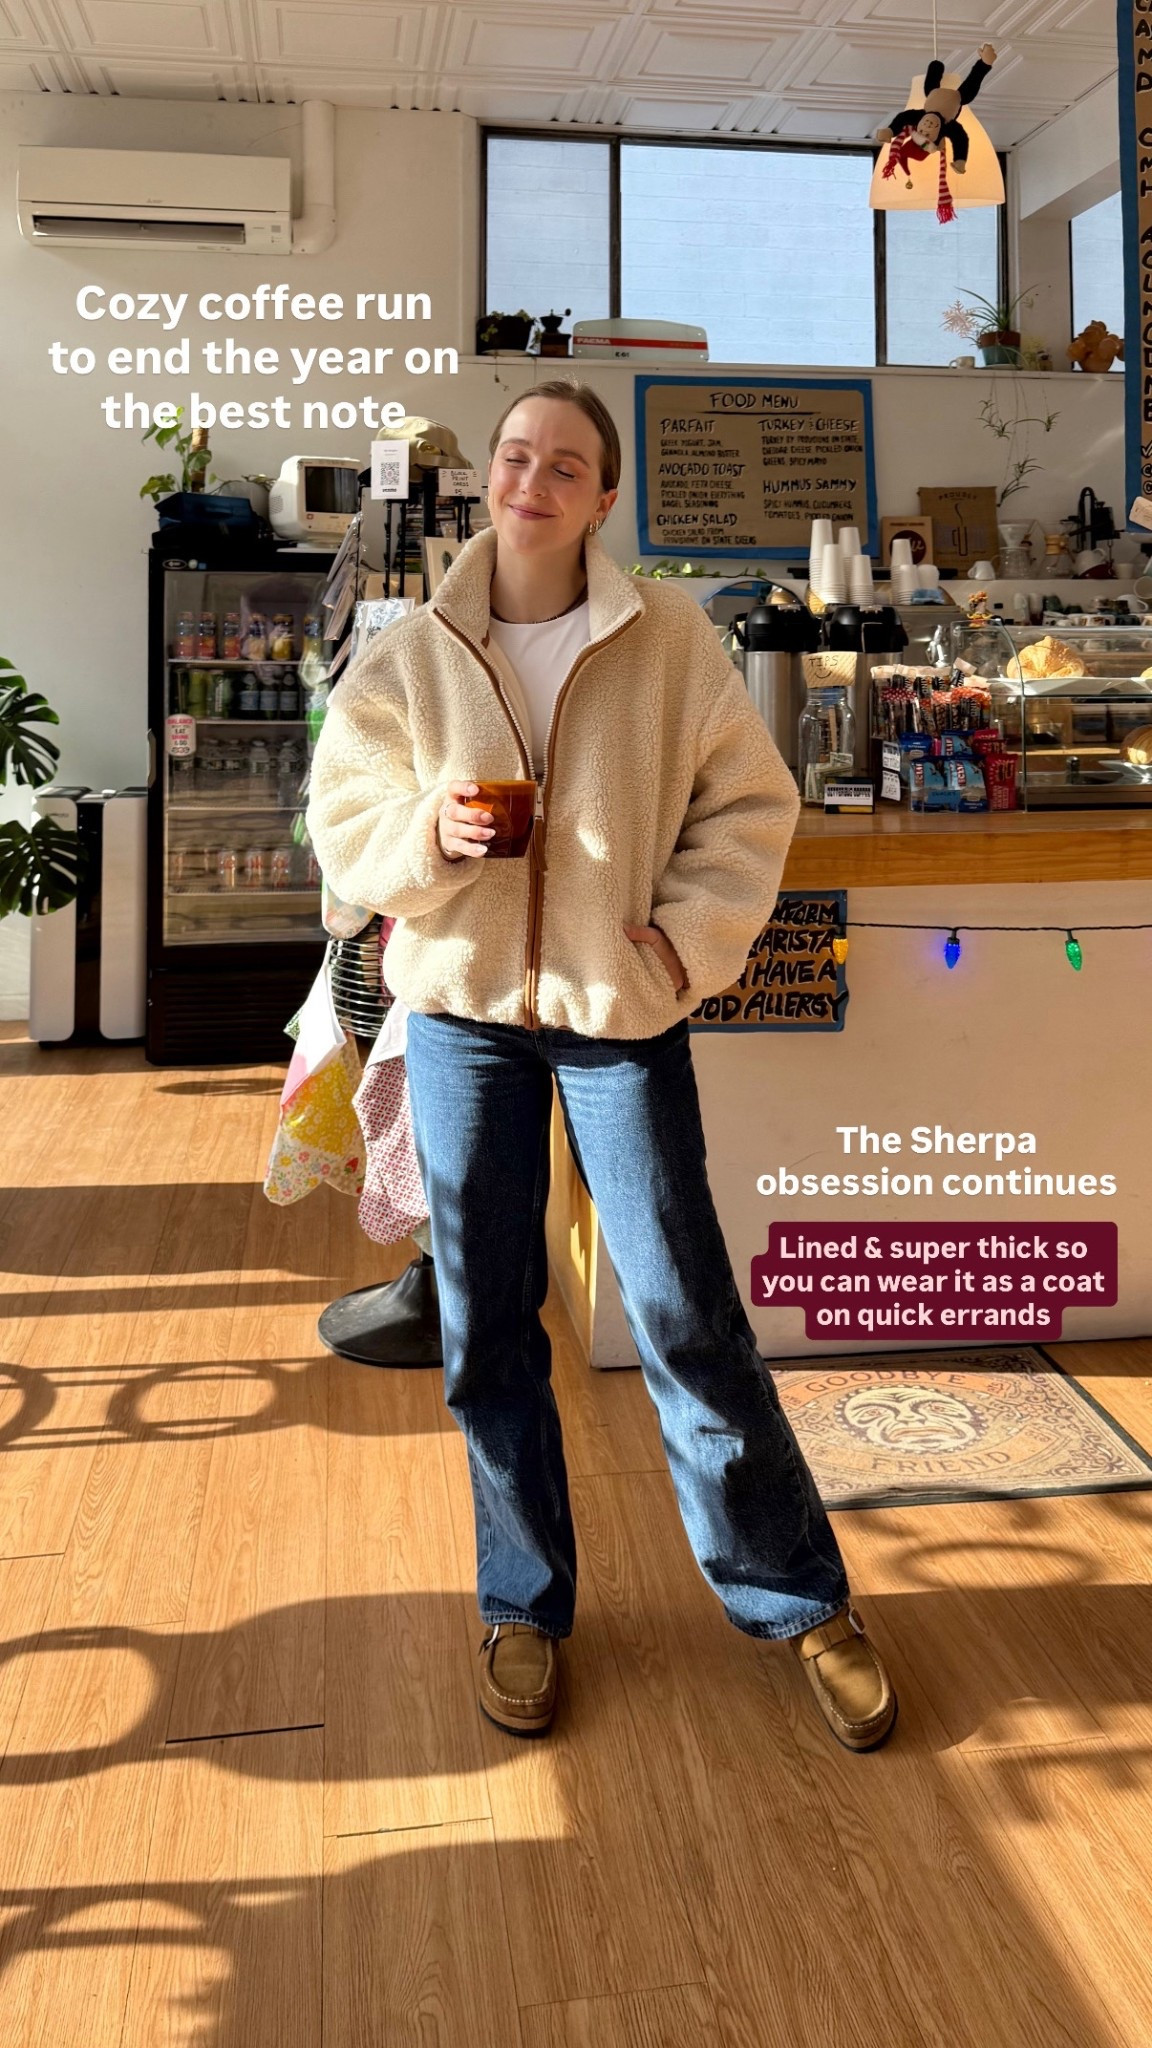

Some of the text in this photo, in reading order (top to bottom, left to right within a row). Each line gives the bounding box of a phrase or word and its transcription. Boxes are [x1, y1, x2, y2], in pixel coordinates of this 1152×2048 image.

[709, 392, 799, 409] FOOD MENU
[660, 418, 717, 435] PARFAIT
[758, 418, 806, 432] TURKEY
[815, 417, 859, 433] CHEESE
[659, 463, 746, 477] AVOCADO TOAST
[763, 478, 857, 494] HUMMUS SAMMY
[657, 513, 738, 526] CHICKEN SALAD
[808, 654, 839, 668] TIPS
[750, 957, 816, 988] HAVE
[815, 958, 838, 983] A
[742, 990, 849, 1022] ALLERGY
[805, 1369, 966, 1393] GOODBYE
[871, 1450, 1011, 1474] FRIEND
